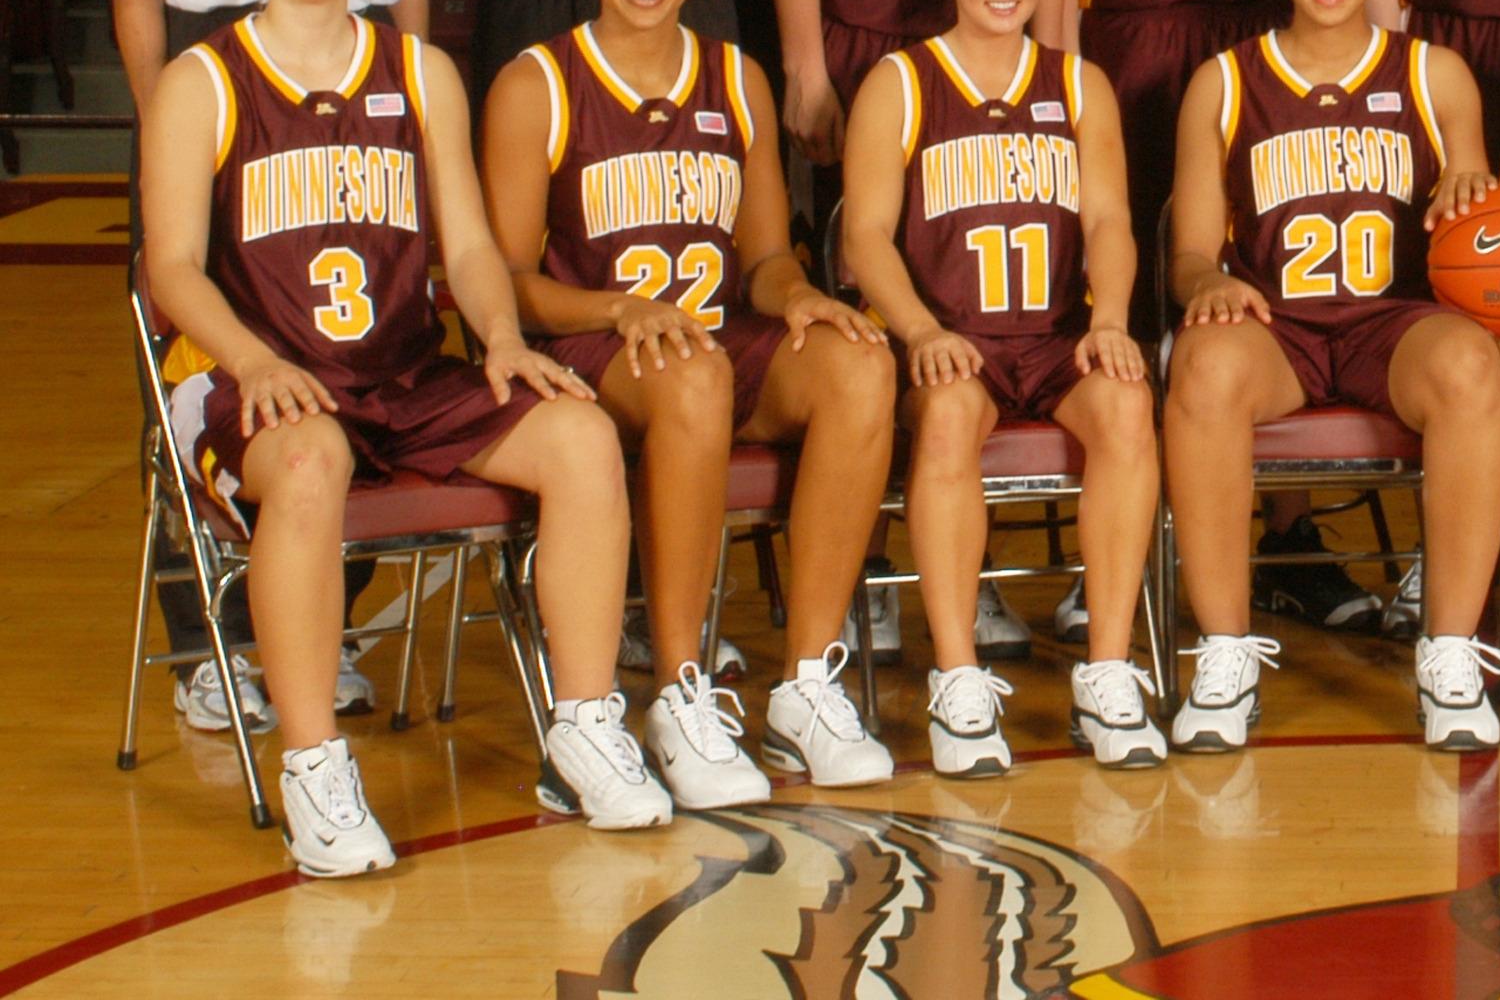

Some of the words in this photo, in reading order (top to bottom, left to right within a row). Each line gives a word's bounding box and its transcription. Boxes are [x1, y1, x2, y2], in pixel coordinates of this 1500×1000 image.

[242, 145, 419, 242] MINNESOTA
[581, 150, 741, 239] MINNESOTA
[922, 133, 1080, 221] MINNESOTA
[1251, 126, 1414, 216] MINNESOTA
[309, 246, 374, 341] 3
[616, 241, 724, 330] 22
[966, 223, 1049, 312] 11
[1282, 210, 1394, 299] 20
